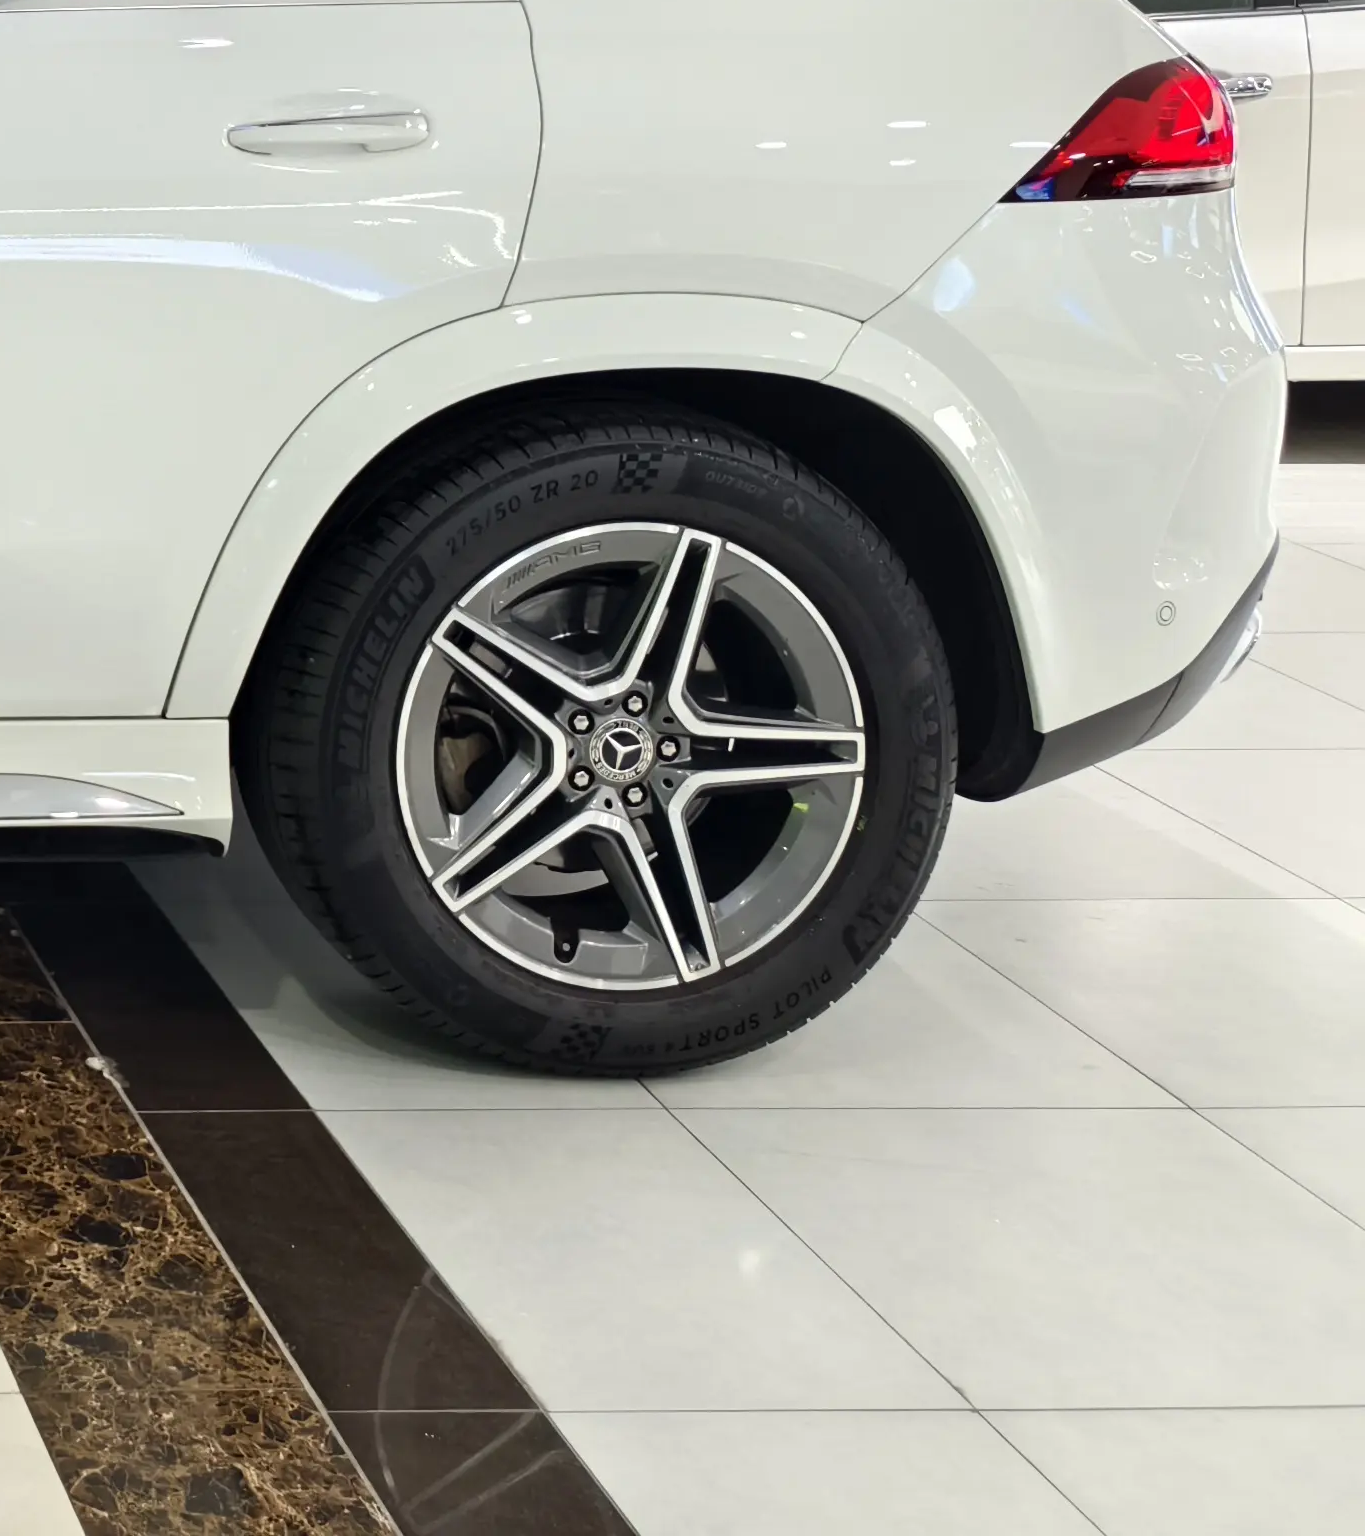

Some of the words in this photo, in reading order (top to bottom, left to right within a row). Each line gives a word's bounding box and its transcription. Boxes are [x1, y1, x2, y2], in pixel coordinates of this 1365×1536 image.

[445, 495, 522, 557] 275/50
[530, 480, 560, 504] ZR
[569, 469, 600, 492] 20
[336, 565, 426, 771] MICHELIN
[772, 965, 834, 1021] PILOT
[679, 1011, 761, 1052] SPORT
